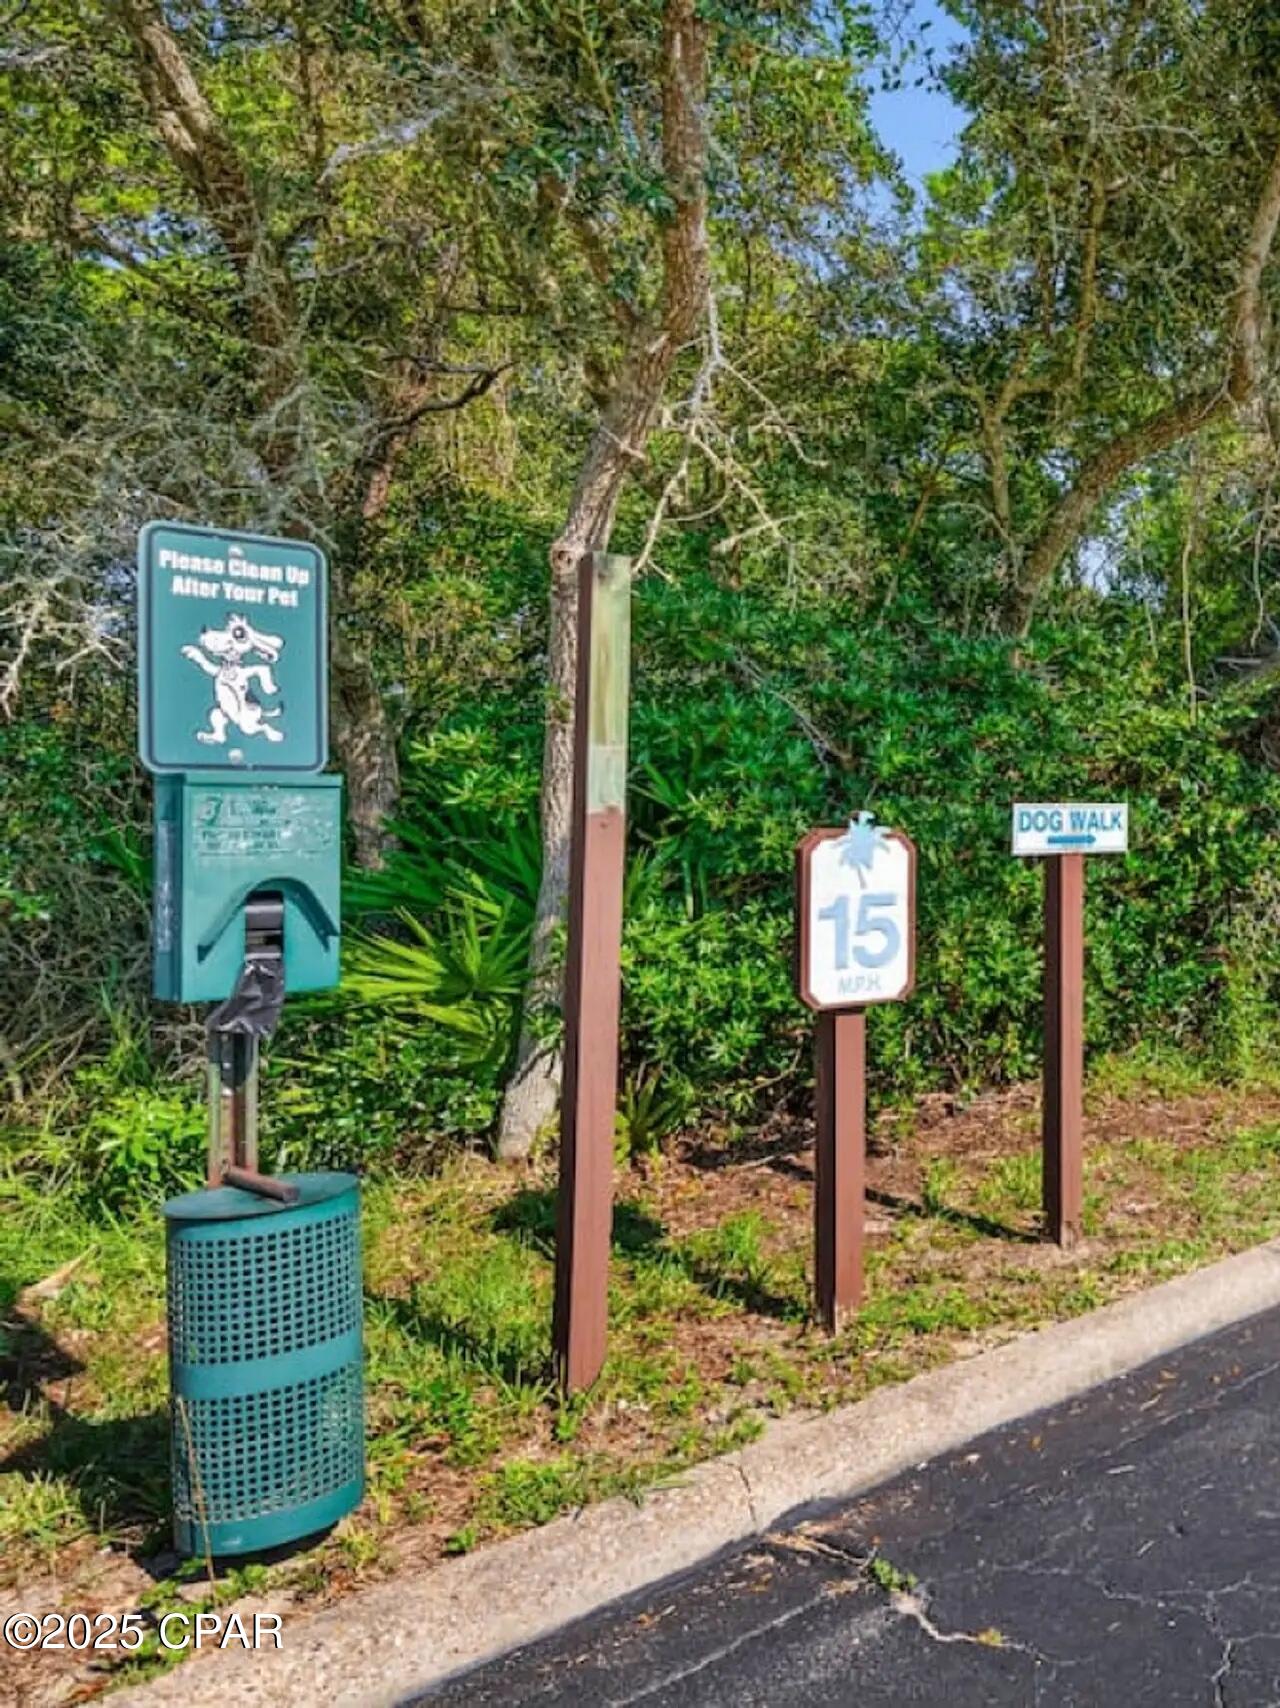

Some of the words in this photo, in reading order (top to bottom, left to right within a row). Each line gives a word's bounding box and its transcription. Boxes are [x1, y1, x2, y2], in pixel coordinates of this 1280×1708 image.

[158, 549, 224, 573] Please
[229, 558, 283, 581] Clean
[286, 566, 309, 586] Up
[172, 575, 219, 599] After
[223, 583, 265, 603] Your
[268, 587, 298, 607] Pet
[1018, 810, 1062, 832] DOG
[1069, 810, 1124, 831] WALK
[818, 890, 901, 970] 15
